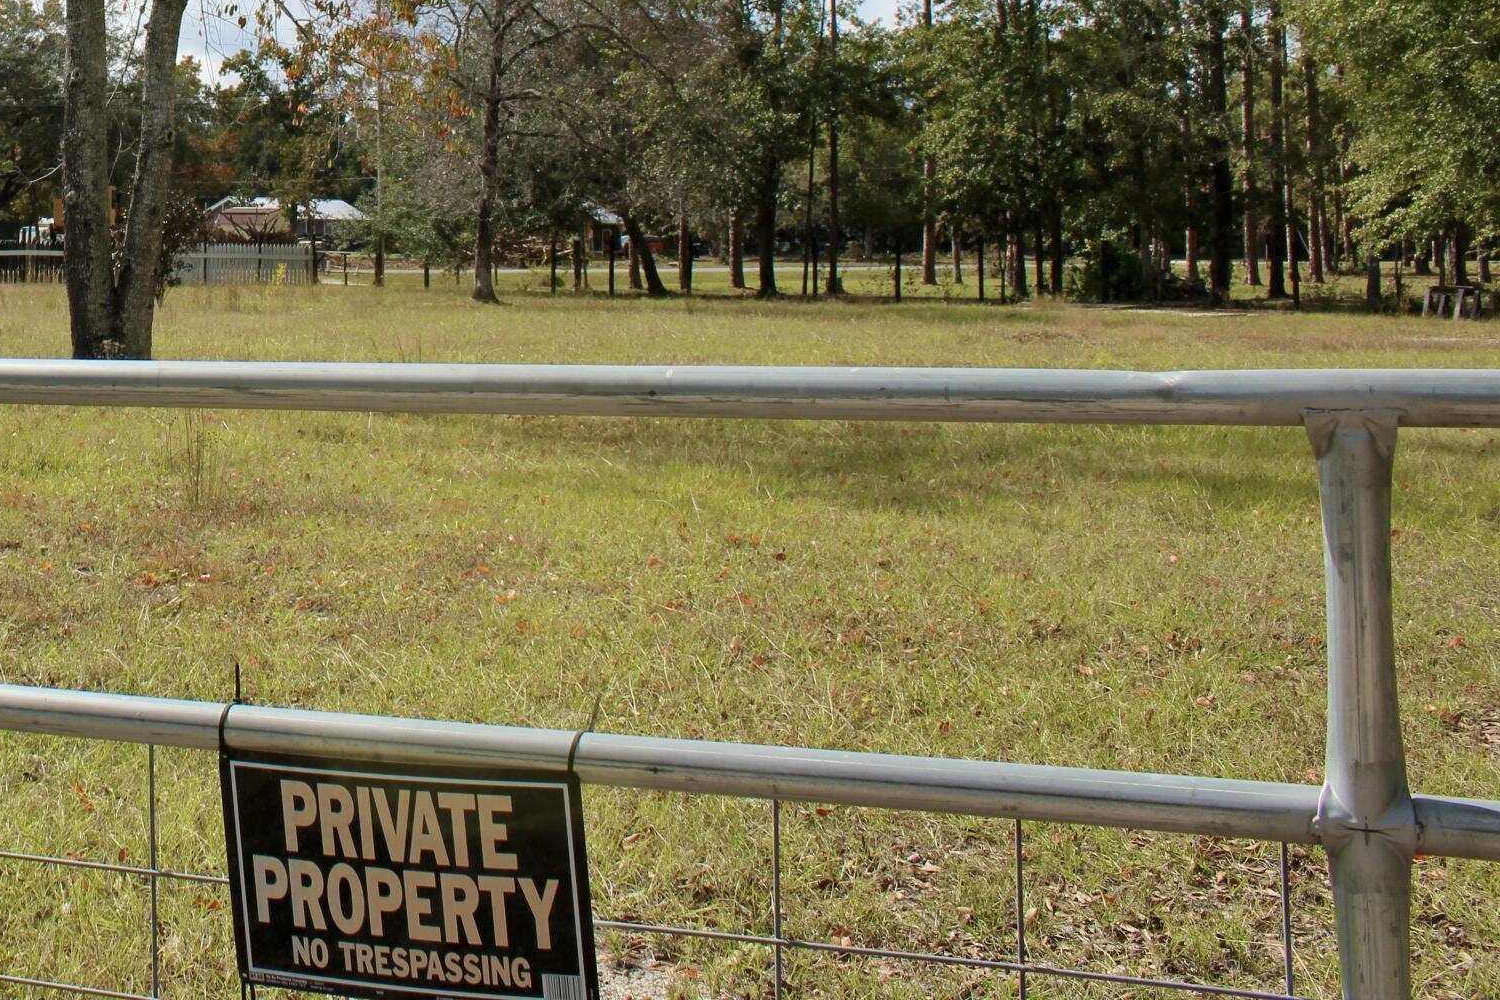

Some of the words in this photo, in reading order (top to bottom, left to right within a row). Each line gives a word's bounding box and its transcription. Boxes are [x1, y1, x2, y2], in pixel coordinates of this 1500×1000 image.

[280, 779, 519, 871] PRIVATE
[252, 854, 560, 950] PROPERTY
[291, 935, 329, 969] NO
[338, 941, 532, 989] TRESPASSING
